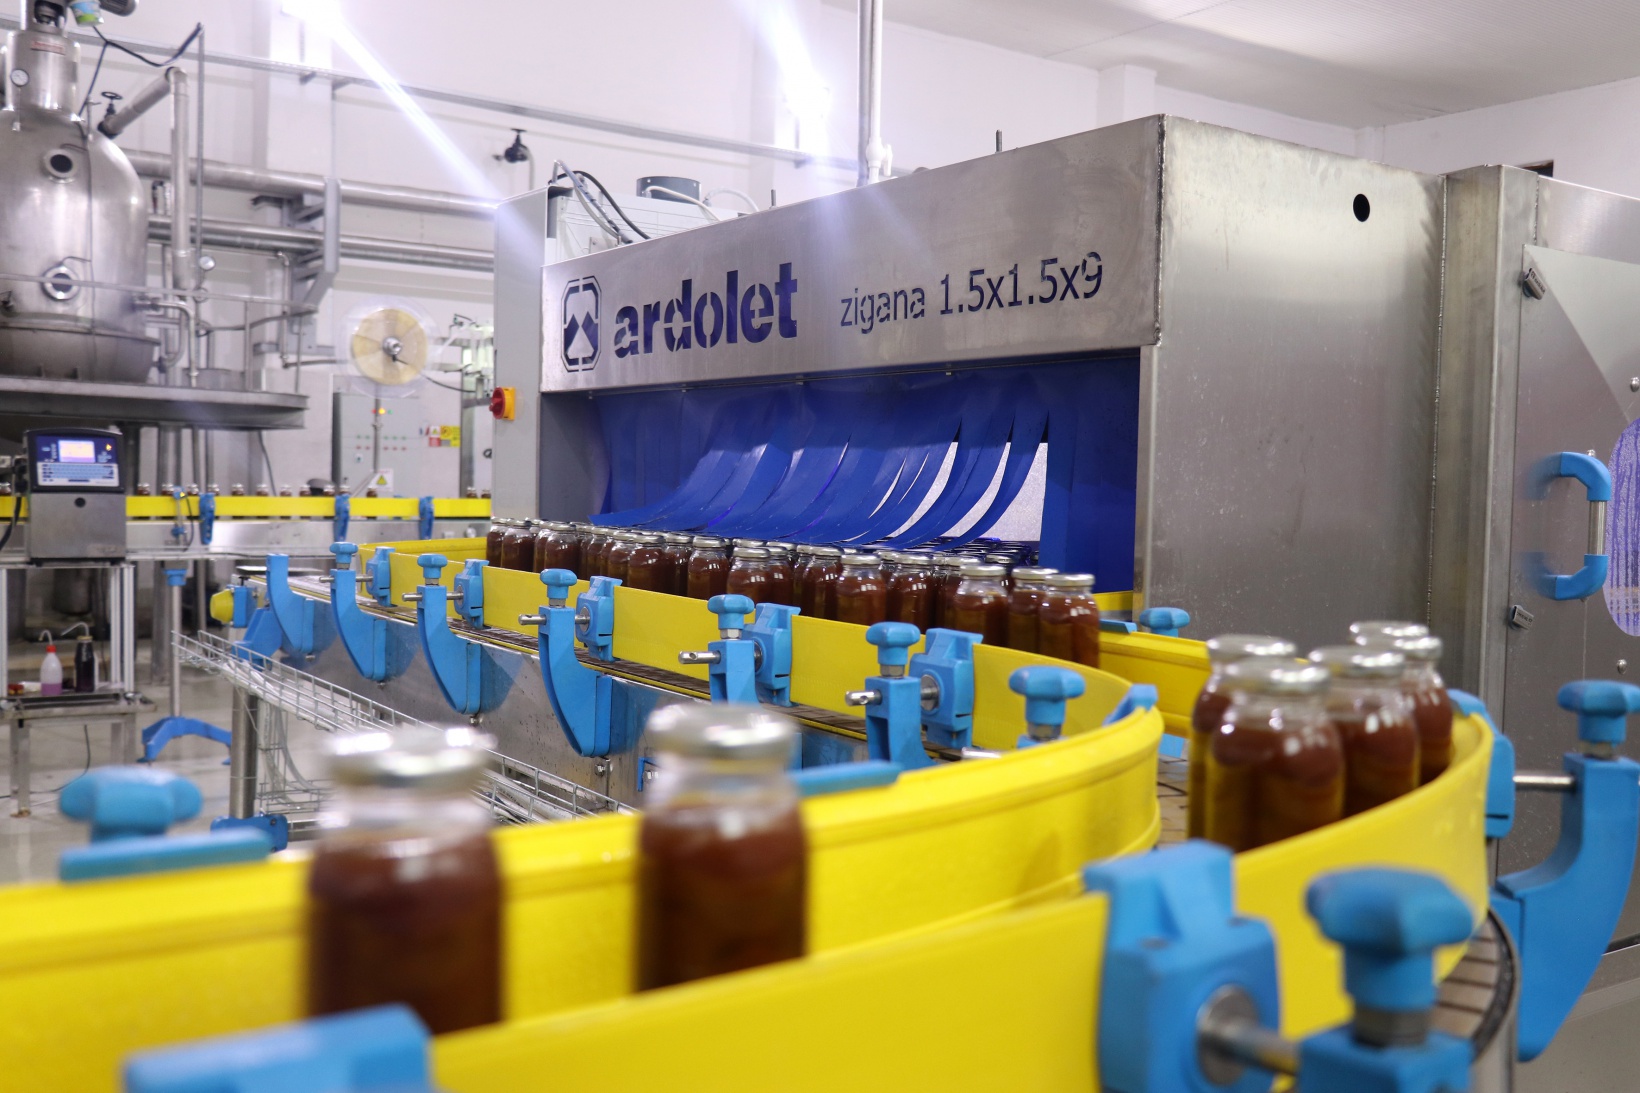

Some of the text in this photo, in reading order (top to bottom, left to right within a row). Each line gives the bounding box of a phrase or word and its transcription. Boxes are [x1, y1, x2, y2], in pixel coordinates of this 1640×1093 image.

[614, 262, 797, 358] ardolet
[840, 251, 1103, 334] zigana 1.5x1.5x9
